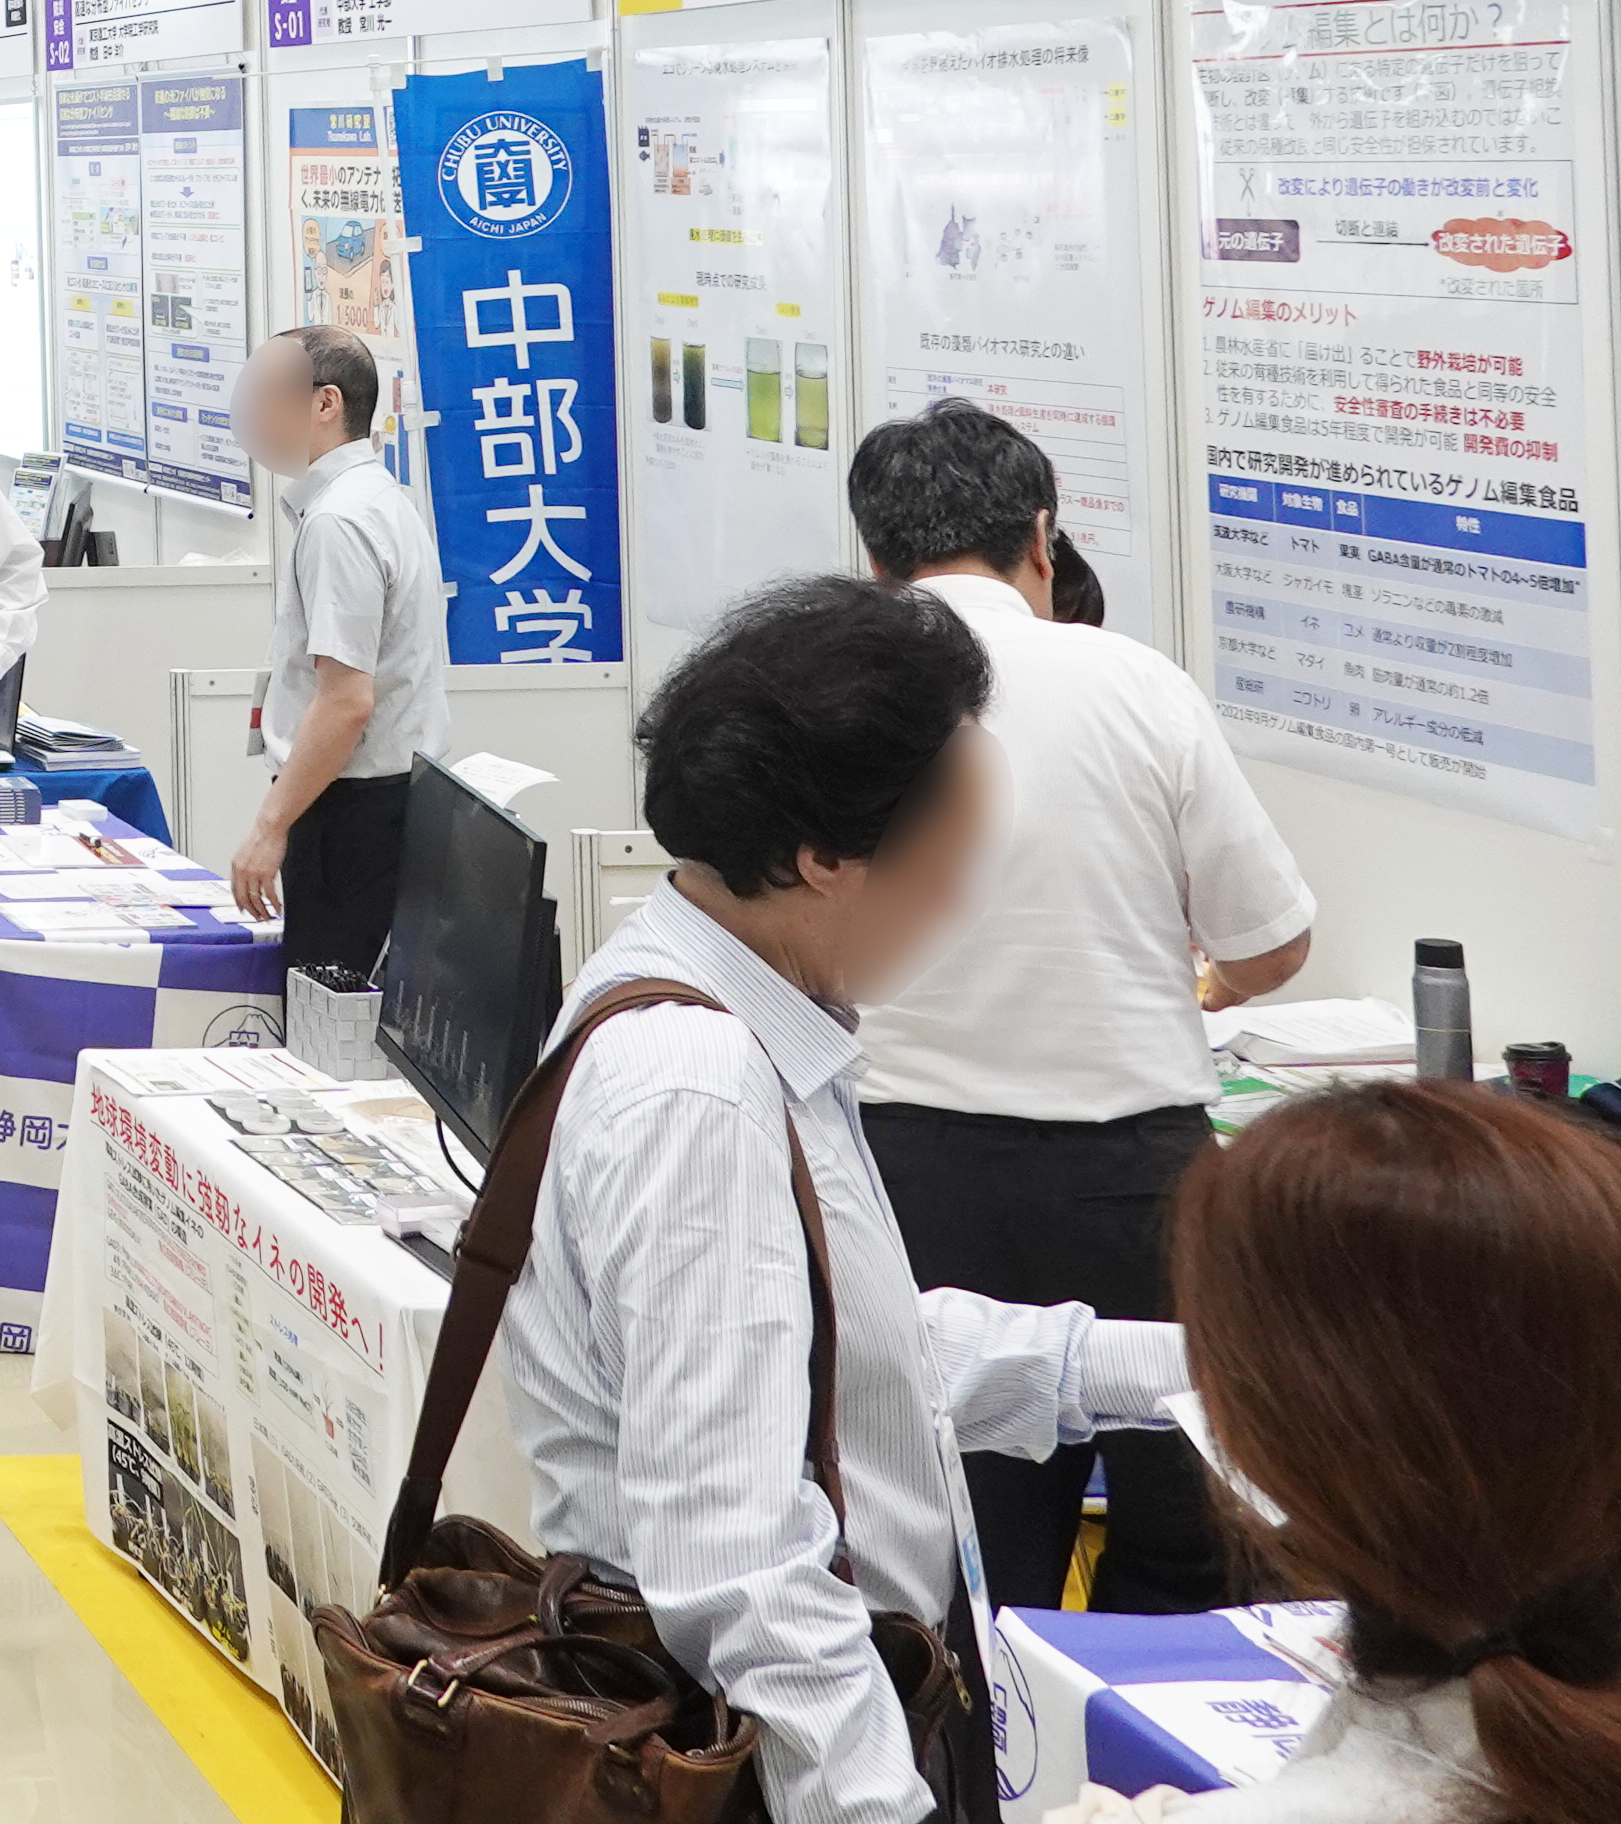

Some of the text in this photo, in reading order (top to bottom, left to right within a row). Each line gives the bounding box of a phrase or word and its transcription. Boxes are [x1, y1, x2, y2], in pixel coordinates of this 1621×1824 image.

[274, 10, 304, 41] S-01
[49, 40, 70, 66] S-02
[442, 115, 568, 181] CHUBU UNIVERSITY
[469, 212, 547, 234] AICHI JAPAN
[1438, 232, 1567, 256] 改変された遺伝子
[1202, 297, 1357, 327] ゲノム編集のメリット
[463, 269, 593, 663] 中部大学
[1291, 535, 1320, 555] トマト
[1292, 690, 1332, 711] ニワトリ
